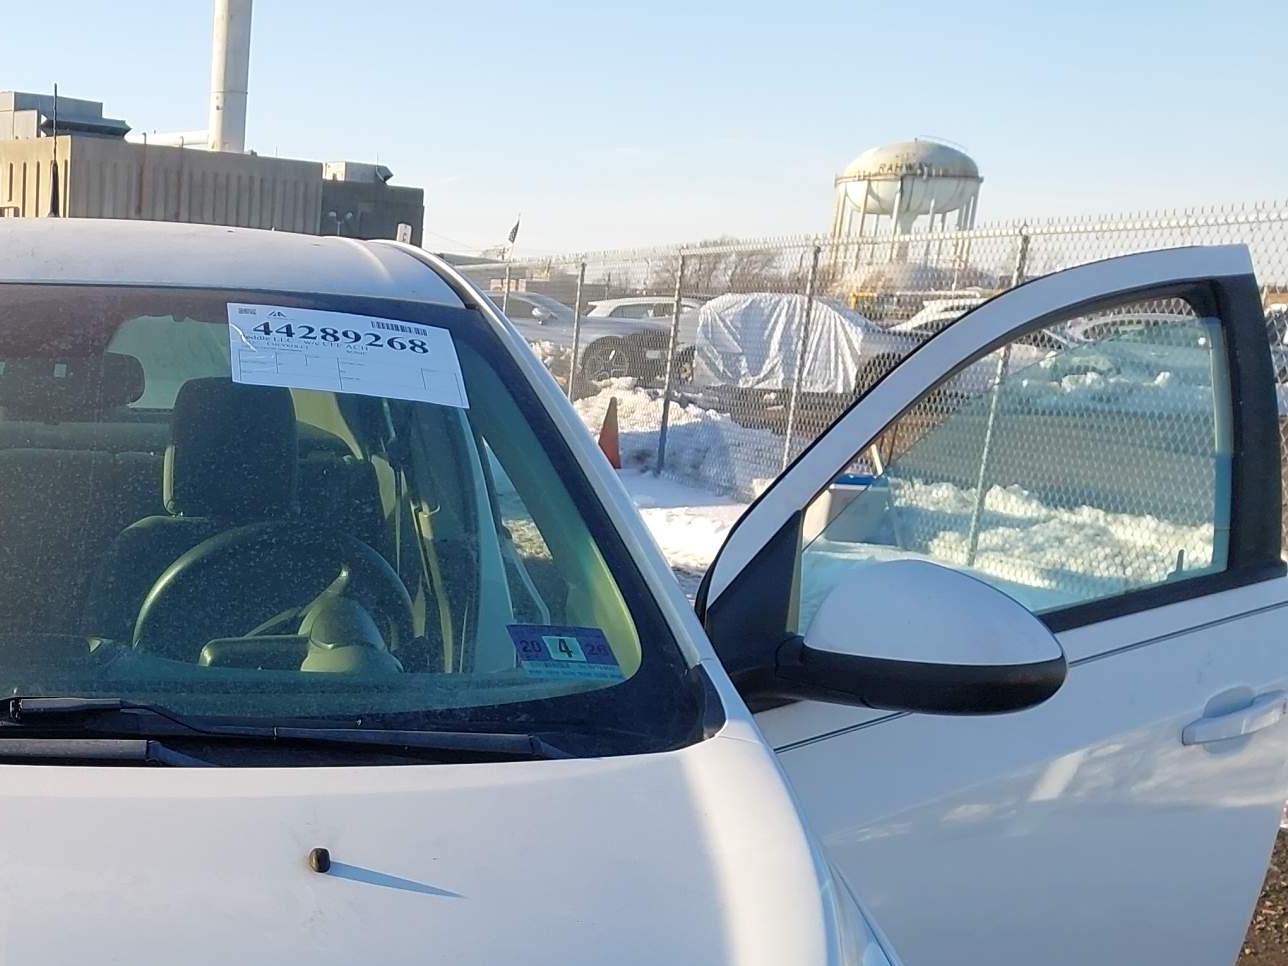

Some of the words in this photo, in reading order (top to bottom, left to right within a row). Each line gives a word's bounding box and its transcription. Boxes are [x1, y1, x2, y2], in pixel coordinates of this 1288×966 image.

[879, 161, 933, 174] RAHWAY
[252, 321, 429, 355] 44289268
[519, 639, 543, 653] 20
[558, 638, 573, 658] 4
